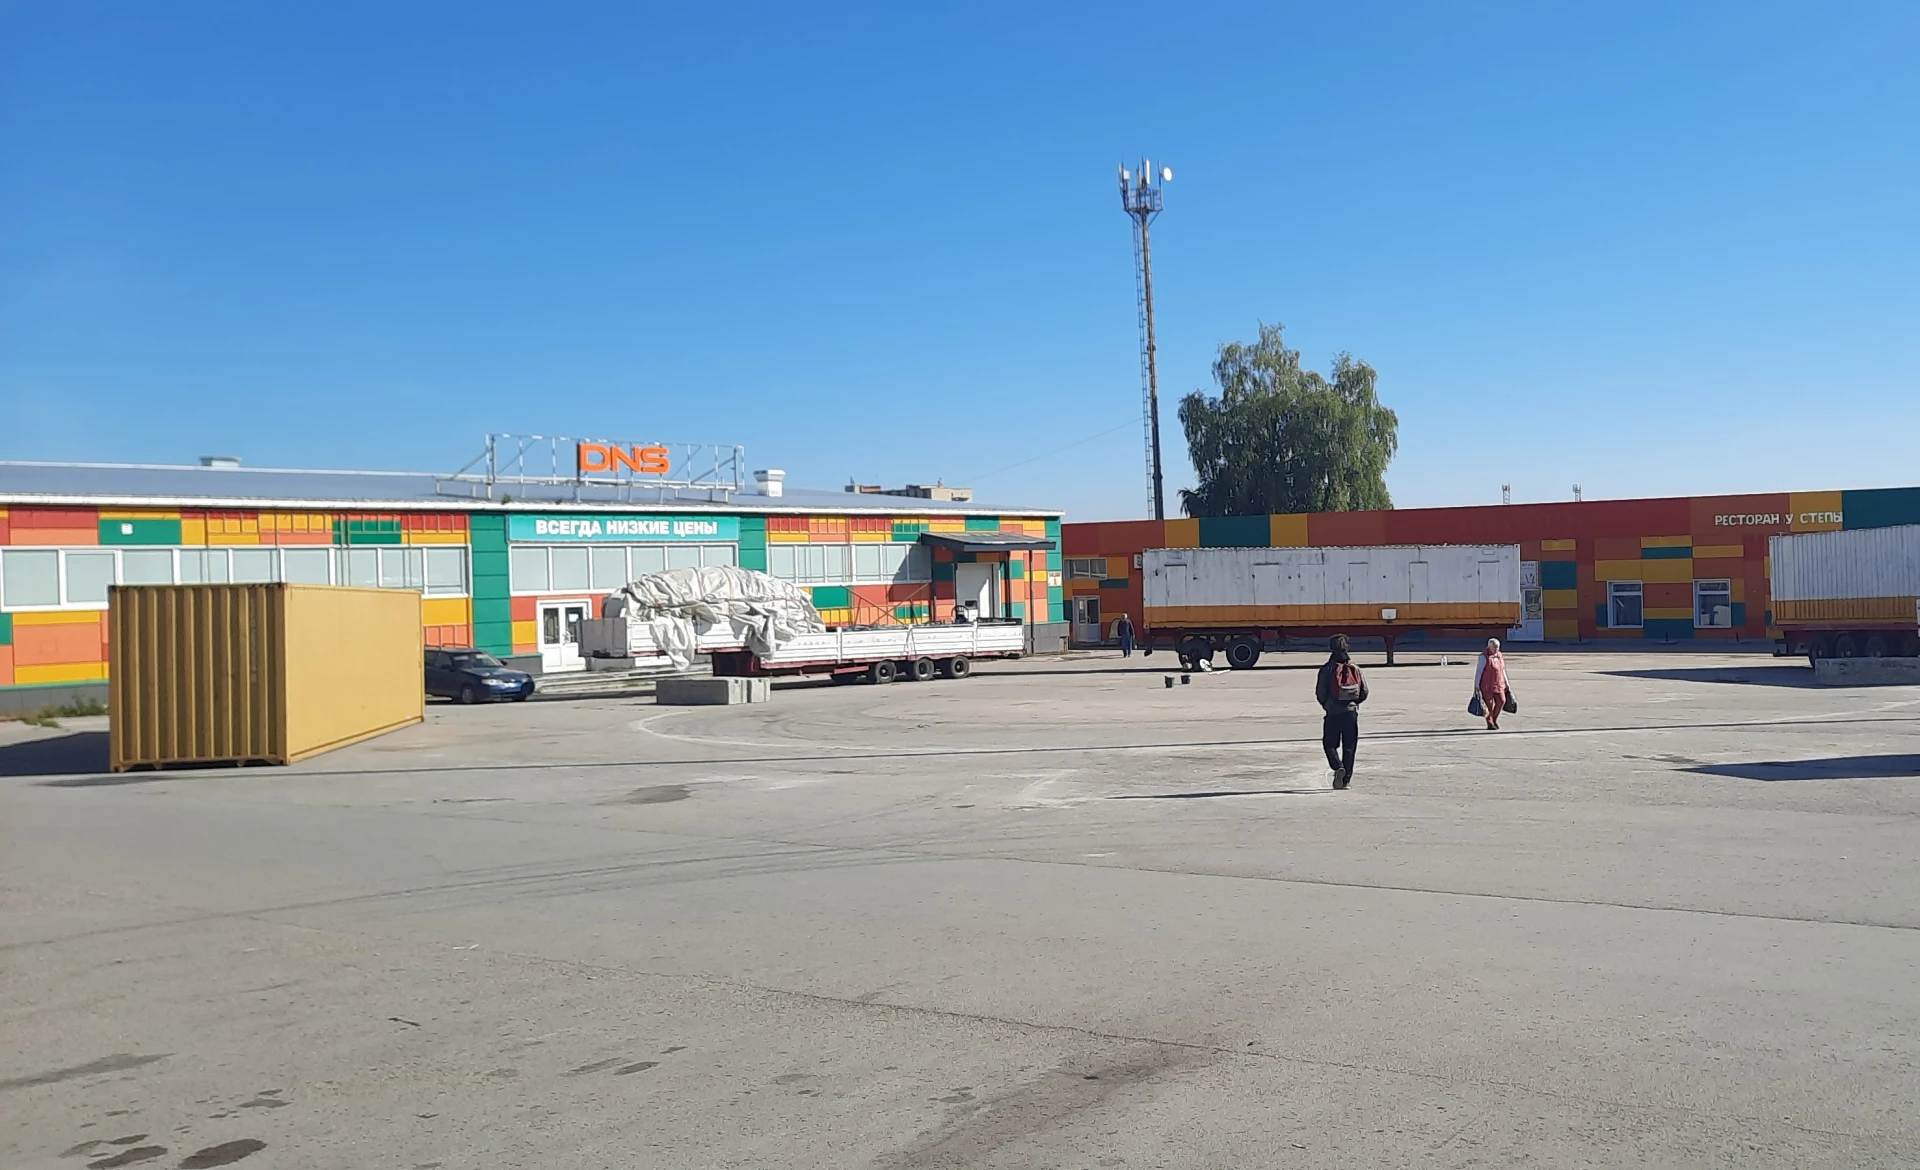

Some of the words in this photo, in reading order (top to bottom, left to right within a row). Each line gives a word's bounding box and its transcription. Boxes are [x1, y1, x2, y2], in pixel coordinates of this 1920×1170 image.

[579, 443, 670, 474] DNS
[1714, 513, 1780, 526] РЕСТОРАН
[1785, 513, 1794, 525] У
[1800, 511, 1843, 524] СТЕПЫ
[535, 519, 602, 538] ВСЕГДА
[606, 520, 670, 536] НИЗКИЕ
[673, 520, 718, 537] ЦЕНЫ
